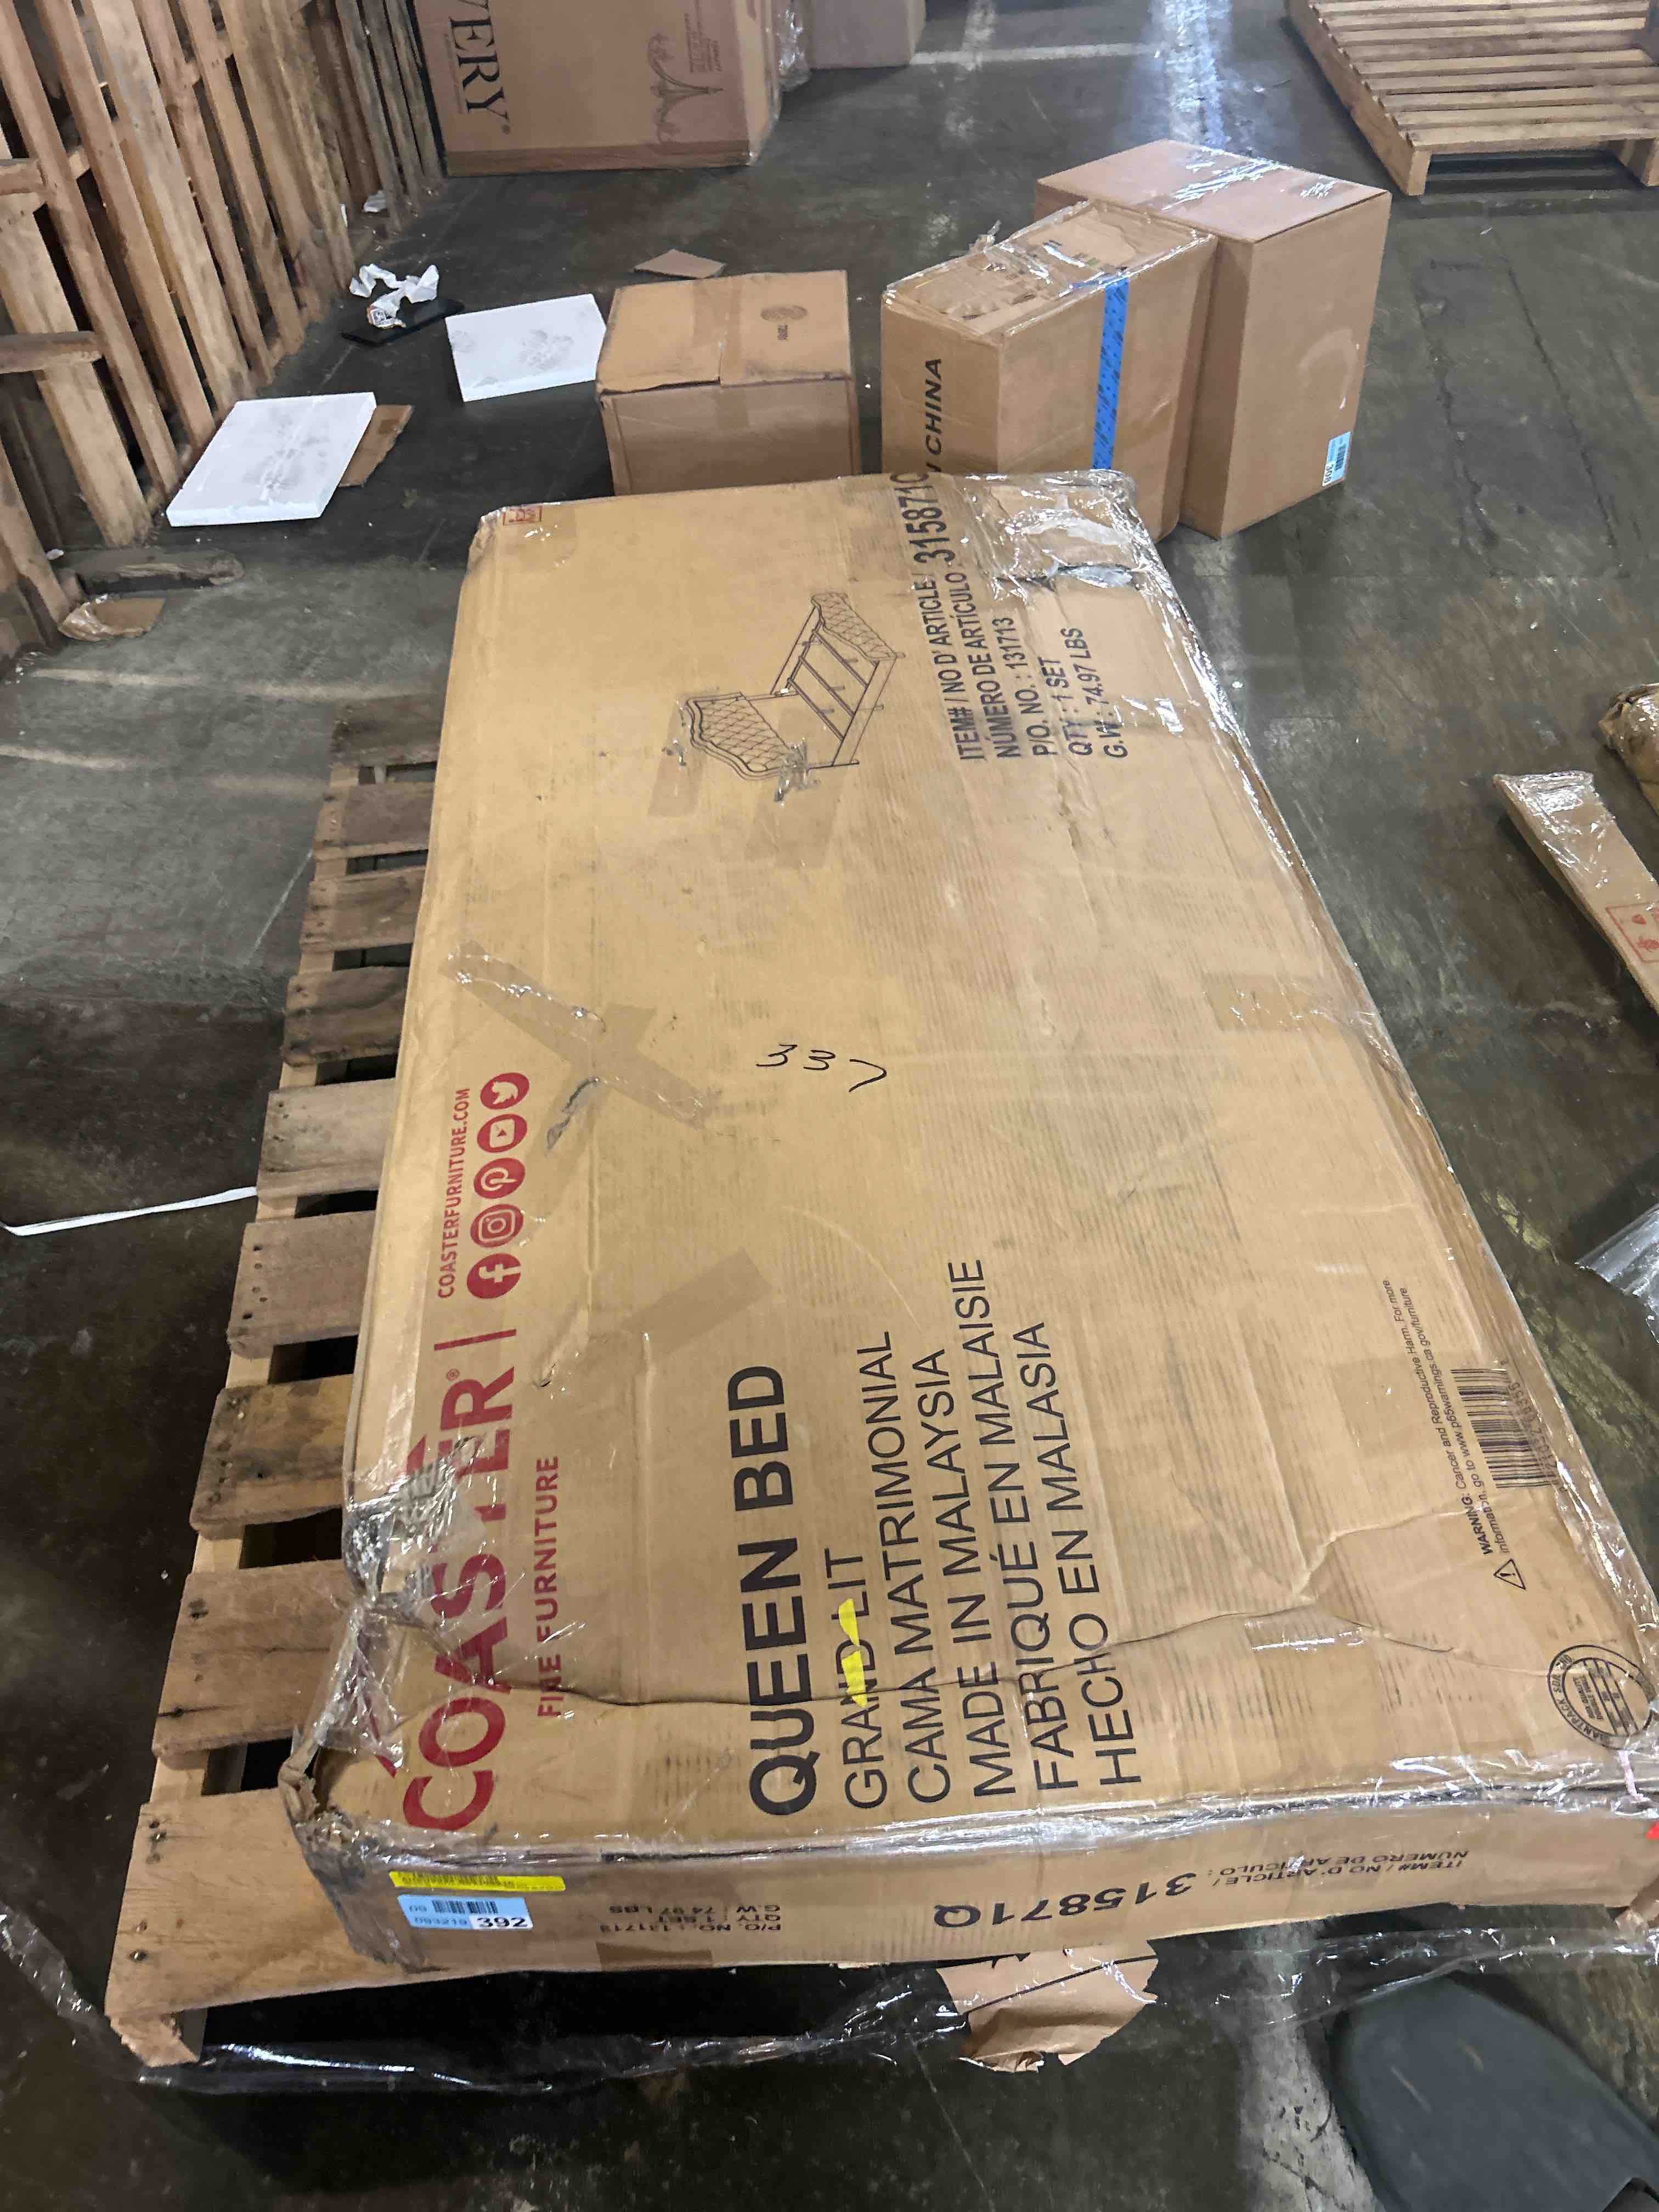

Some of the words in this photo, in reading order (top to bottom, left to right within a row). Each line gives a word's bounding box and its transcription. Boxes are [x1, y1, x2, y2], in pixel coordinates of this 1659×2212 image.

[924, 358, 942, 456] CHINA
[944, 572, 988, 649] ARTÍCULO
[968, 653, 996, 675] DE
[992, 617, 1028, 669] 131713
[1037, 656, 1069, 689] SET
[1060, 628, 1092, 658] LBS
[938, 669, 966, 693] NO
[1073, 663, 1109, 704] 74.97
[948, 706, 985, 759] ITEM#
[977, 680, 1022, 758] NÚMERO
[438, 1088, 470, 1299] COASTERFURNITURE.COM
[1383, 1280, 1398, 1304] more
[1392, 1306, 1404, 1322] For
[948, 1259, 1015, 1445] MALAISIE
[1013, 1322, 1084, 1511] MALASIA
[1412, 1357, 1443, 1424] Reproductive
[727, 1365, 793, 1511] BED
[912, 1349, 981, 1576] MALAYSIA
[1436, 1427, 1451, 1447] and
[1465, 1460, 1476, 1470] to
[857, 1331, 934, 1655] MATRIMONIAL
[984, 1463, 1030, 1523] EN
[1446, 1451, 1466, 1488] Cancer
[1471, 1474, 1484, 1488] go
[534, 1457, 559, 1642] FURNITURE
[1052, 1530, 1099, 1595] EN
[825, 1548, 869, 1620] LIT
[947, 1594, 992, 1643] IN
[538, 1654, 564, 1717] FINE
[737, 1538, 820, 1815] QUEEN
[989, 1542, 1079, 1790] FABRIQUÉ
[957, 1661, 1016, 1797] MADE
[1068, 1613, 1141, 1786] HECHO
[899, 1667, 951, 1803] CAMA
[1333, 1855, 1365, 1865] DE
[1350, 1864, 1380, 1874] NO
[1398, 1860, 1463, 1871] ITEM#
[477, 1917, 528, 1928] 392
[933, 1872, 1197, 1928] 315871Q
